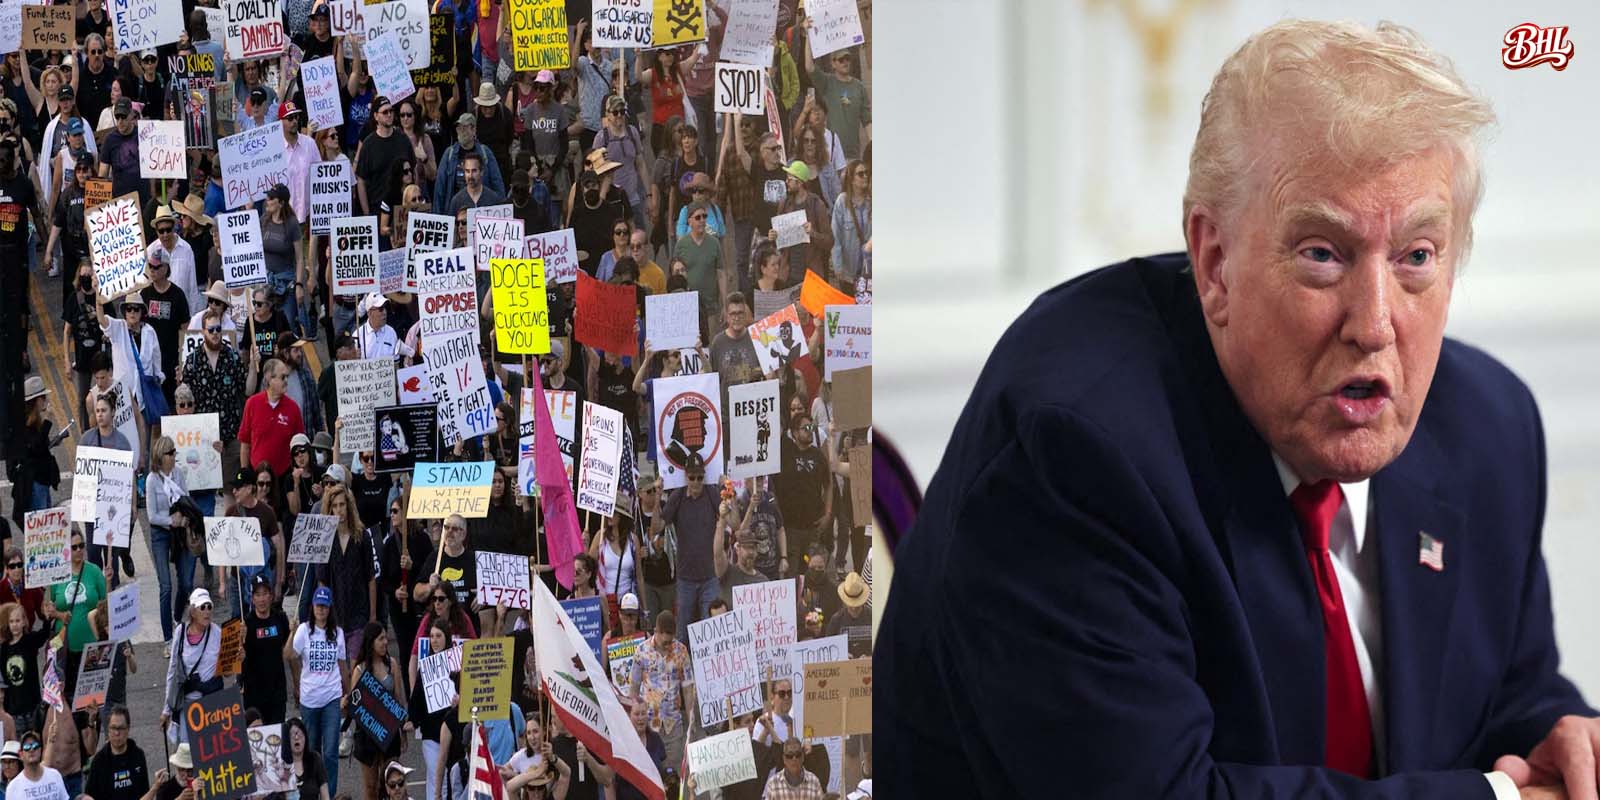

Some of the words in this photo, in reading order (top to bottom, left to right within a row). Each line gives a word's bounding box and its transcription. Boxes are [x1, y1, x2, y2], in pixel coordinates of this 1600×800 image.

[43, 17, 56, 26] not
[51, 6, 72, 18] Facts
[228, 2, 276, 22] LOYALTY
[332, 2, 364, 33] Ugh
[381, 3, 406, 23] NO
[514, 9, 567, 30] OLIGARCHY
[594, 9, 608, 20] THE
[608, 7, 652, 25] OLIGARCHY
[33, 25, 68, 44] Felons
[118, 25, 139, 38] GO
[120, 30, 158, 50] AWAY
[227, 24, 240, 38] BE
[241, 22, 283, 51] DAMNED
[518, 36, 529, 46] NO
[530, 33, 569, 45] UNELECTED
[607, 25, 621, 40] ALL
[635, 26, 651, 44] US
[168, 56, 185, 73] NO
[187, 54, 214, 72] KINGS
[518, 48, 570, 68] BILLIONAIRES
[171, 73, 215, 91] America
[304, 67, 318, 81] DO
[321, 64, 333, 79] YOU
[305, 88, 323, 99] HEAR
[720, 69, 761, 108] STOP!
[312, 99, 335, 113] PEOPLE
[532, 118, 556, 129] NOPE
[149, 134, 166, 147] THIS
[149, 147, 184, 172] SCAM
[317, 164, 342, 178] STOP
[86, 191, 111, 199] FASCIST
[228, 168, 290, 206] BALANCES
[312, 181, 349, 195] MUSK'S
[313, 203, 334, 215] WAR
[337, 202, 349, 213] ON
[97, 205, 130, 232] SAVE
[227, 214, 250, 228] STOP
[414, 219, 448, 232] HANDS
[97, 225, 132, 246] VOTING
[232, 231, 250, 245] THE
[337, 226, 372, 236] HANDS
[412, 230, 448, 248] OFF!
[102, 236, 135, 256] RIGHTS
[337, 236, 373, 251] OFF!
[528, 235, 568, 260] Blood
[101, 245, 141, 269] PROTECT
[224, 252, 263, 265] BILLIONAIRE
[336, 254, 376, 269] SOCIAL
[424, 256, 466, 276] REAL
[554, 257, 570, 267] on
[99, 257, 146, 286] DEMOCRACY
[231, 264, 260, 279] COUP!
[336, 267, 376, 279] SECURITY
[492, 263, 541, 288] DOGE
[419, 273, 474, 293] AMERICANS
[425, 292, 476, 314] OPPOSE
[508, 291, 529, 307] IS
[422, 312, 476, 333] DICTATORS
[495, 311, 547, 329] CUCKING
[508, 331, 532, 348] YOU
[845, 338, 854, 350] 4
[423, 346, 447, 371] YOU
[447, 332, 475, 364] FIGHT
[827, 349, 869, 361] DEMOCRACY
[429, 373, 446, 389] FOR
[433, 390, 450, 404] THE
[438, 403, 455, 421] WE
[457, 387, 485, 415] FIGHT
[667, 405, 678, 418] NOT
[684, 396, 711, 414] PRESIDENT
[735, 397, 775, 417] RESIST
[442, 420, 457, 435] FOR
[466, 403, 493, 433] 99%
[427, 465, 482, 484] STAND
[435, 488, 471, 497] WITH
[411, 497, 486, 513] UKRAINE
[208, 519, 227, 549] TARIFF
[240, 520, 261, 543] THIS
[482, 570, 523, 589] SINCE
[480, 585, 528, 608] 1776
[691, 608, 744, 645] WOMEN
[310, 641, 337, 650] RESIST
[692, 643, 711, 660] have
[714, 638, 731, 653] gone
[310, 651, 336, 661] RESIST
[310, 661, 335, 673] RESIST
[702, 650, 749, 682] ENOUGH
[806, 667, 840, 679] AMERICANS
[360, 671, 381, 697] RAGE
[379, 692, 408, 722] AGAINST
[426, 678, 451, 711] FOR
[547, 677, 599, 727] CALIFORNIA
[818, 689, 840, 700] ALLIES
[188, 702, 241, 732] Orange
[701, 699, 731, 725] GOING
[355, 705, 387, 742] MACHINE
[199, 727, 241, 762] LIES
[690, 741, 725, 765] HANDS
[728, 733, 746, 757] OFF
[199, 760, 253, 799] Matter
